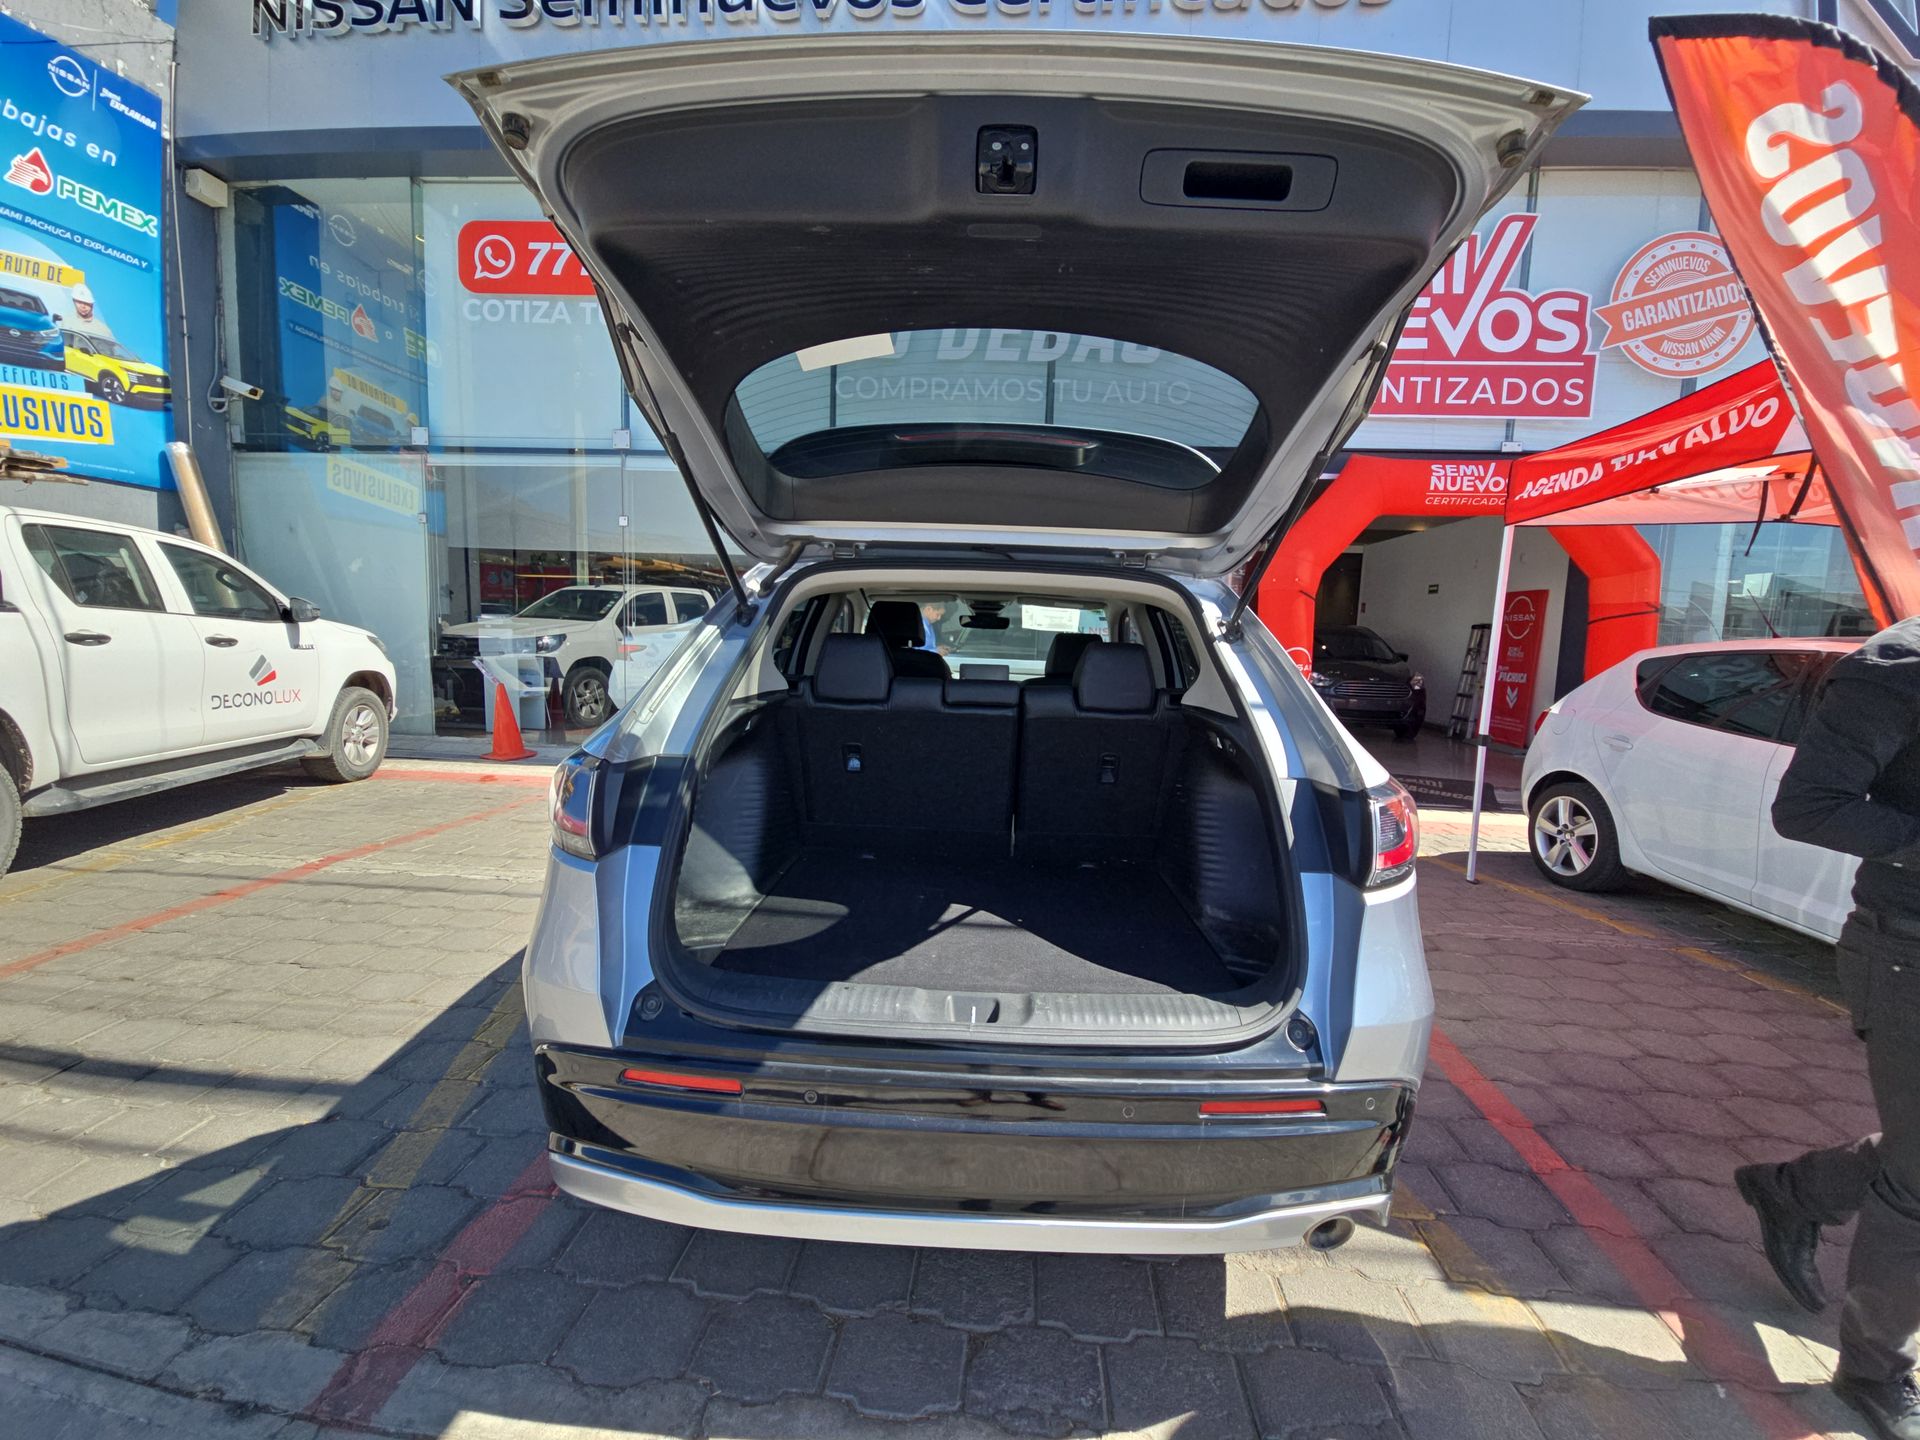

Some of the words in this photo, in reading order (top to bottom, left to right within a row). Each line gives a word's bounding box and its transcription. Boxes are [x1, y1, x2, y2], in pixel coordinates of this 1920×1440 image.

[47, 62, 90, 90] NISSAN
[2, 98, 77, 148] bajas
[86, 143, 117, 167] en
[57, 175, 158, 239] PEMEX
[25, 216, 72, 240] PACHUCA
[73, 234, 82, 244] O
[83, 238, 140, 267] EXPLANADA
[140, 261, 149, 269] Y
[0, 255, 40, 276] RUTA
[47, 266, 63, 283] DE
[1644, 256, 1711, 287] SEMINUEVOS
[1395, 221, 1581, 358] EVOS
[462, 299, 571, 325] COTIZA
[1659, 339, 1700, 357] NISSAN
[1699, 326, 1727, 351] NAMI
[2, 366, 69, 390] EFICIOS
[835, 375, 1043, 402] COMPRAMOS
[1053, 379, 1092, 403] TU
[1102, 379, 1191, 405] AUTO
[1380, 376, 1584, 406] NTIZADOS
[0, 394, 103, 437] USIVOS
[1429, 463, 1508, 493] NUEVO
[1431, 464, 1485, 477] SEMI
[1514, 462, 1604, 500] AGENDA
[1425, 497, 1506, 506] CERTIFICADO
[1503, 614, 1536, 622] NISSAN
[211, 688, 301, 710] DECONOLUX
